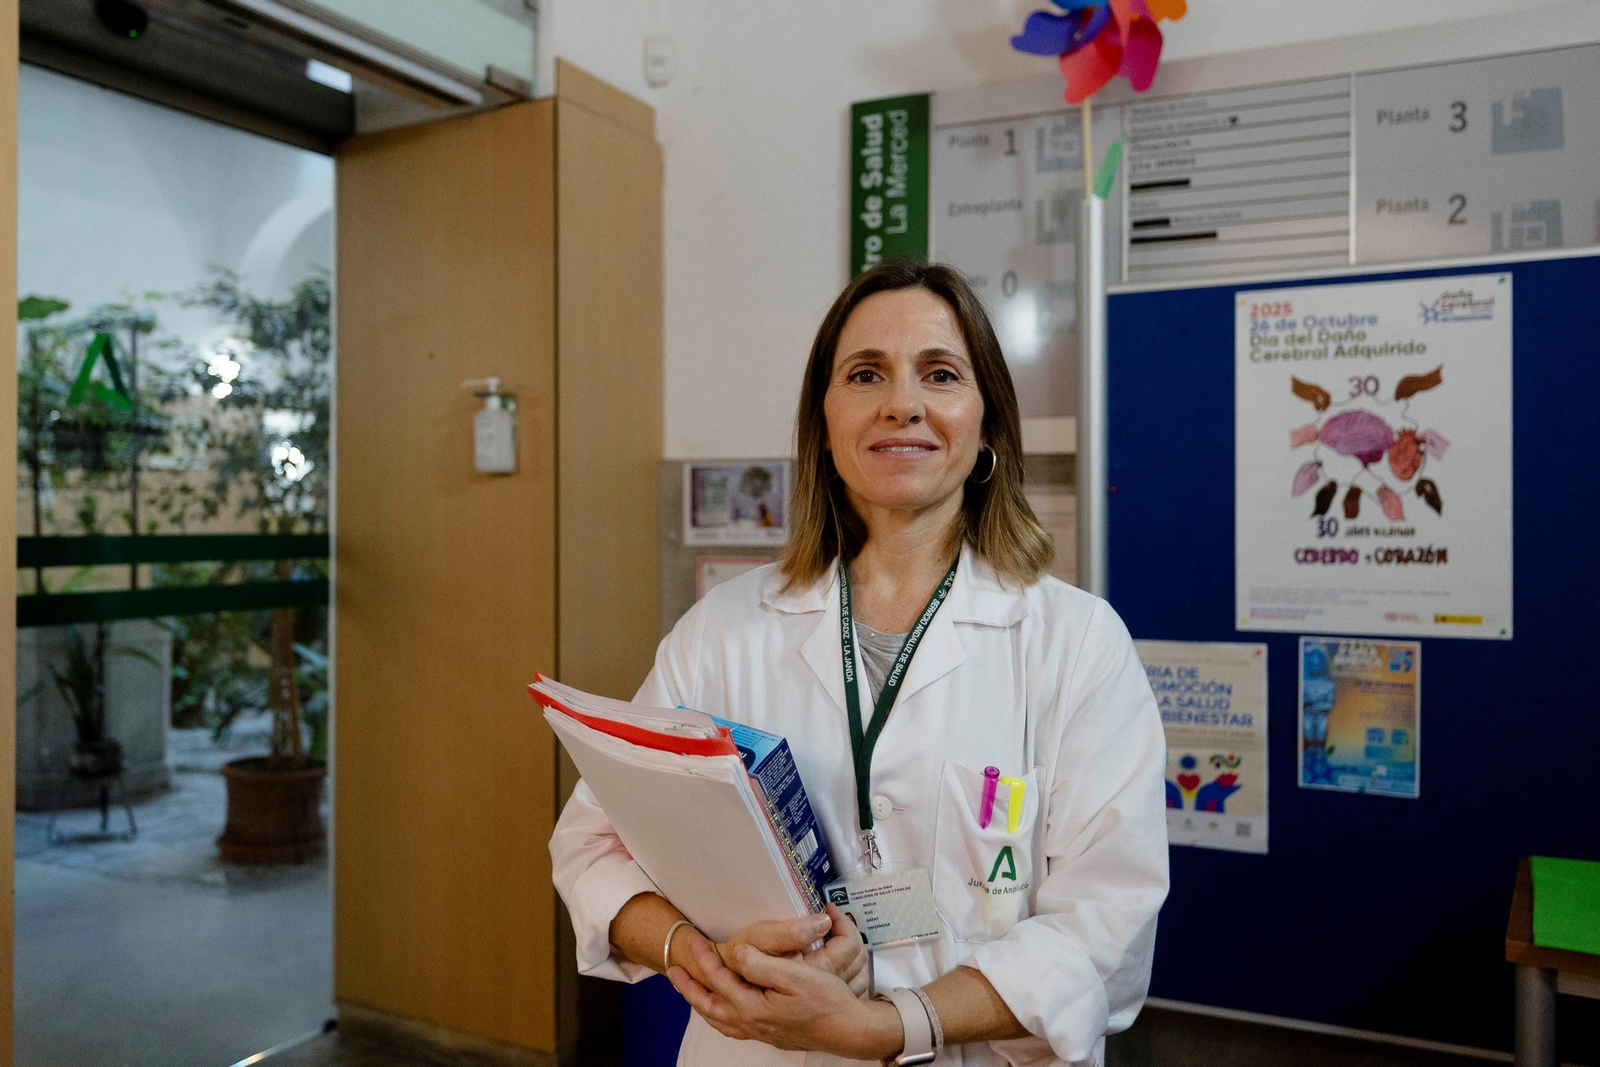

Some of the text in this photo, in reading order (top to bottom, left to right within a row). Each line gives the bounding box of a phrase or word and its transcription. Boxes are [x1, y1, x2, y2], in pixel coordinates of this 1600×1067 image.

[1376, 100, 1468, 133] Planta 3
[860, 112, 884, 190] Salud
[1004, 128, 1018, 156] 1
[884, 108, 909, 235] La Merced
[860, 195, 884, 230] de
[1375, 192, 1467, 225] Planta 2
[1002, 270, 1019, 298] 0
[1250, 301, 1293, 318] 2025
[1275, 318, 1298, 332] de
[1302, 313, 1378, 330] Octubre
[1285, 329, 1312, 345] del
[1318, 326, 1367, 343] Daño
[1250, 340, 1427, 363] Cerebral Adquirido
[1348, 375, 1380, 398] 30
[1317, 517, 1339, 538] 30
[1374, 544, 1449, 568] CORAZÓN
[841, 586, 849, 607] BAHIA
[842, 607, 849, 617] DE
[842, 617, 850, 639] CADIZ
[843, 645, 851, 656] LA
[888, 598, 940, 687] SERVICIO ANDALUZ DE SALUD
[844, 656, 854, 683] JANDA
[1177, 665, 1199, 679] DE
[1150, 678, 1234, 696] OMOCIÓN
[1176, 696, 1231, 710] SALUD
[1161, 710, 1254, 727] BIENESTAR
[992, 885, 1003, 896] de
